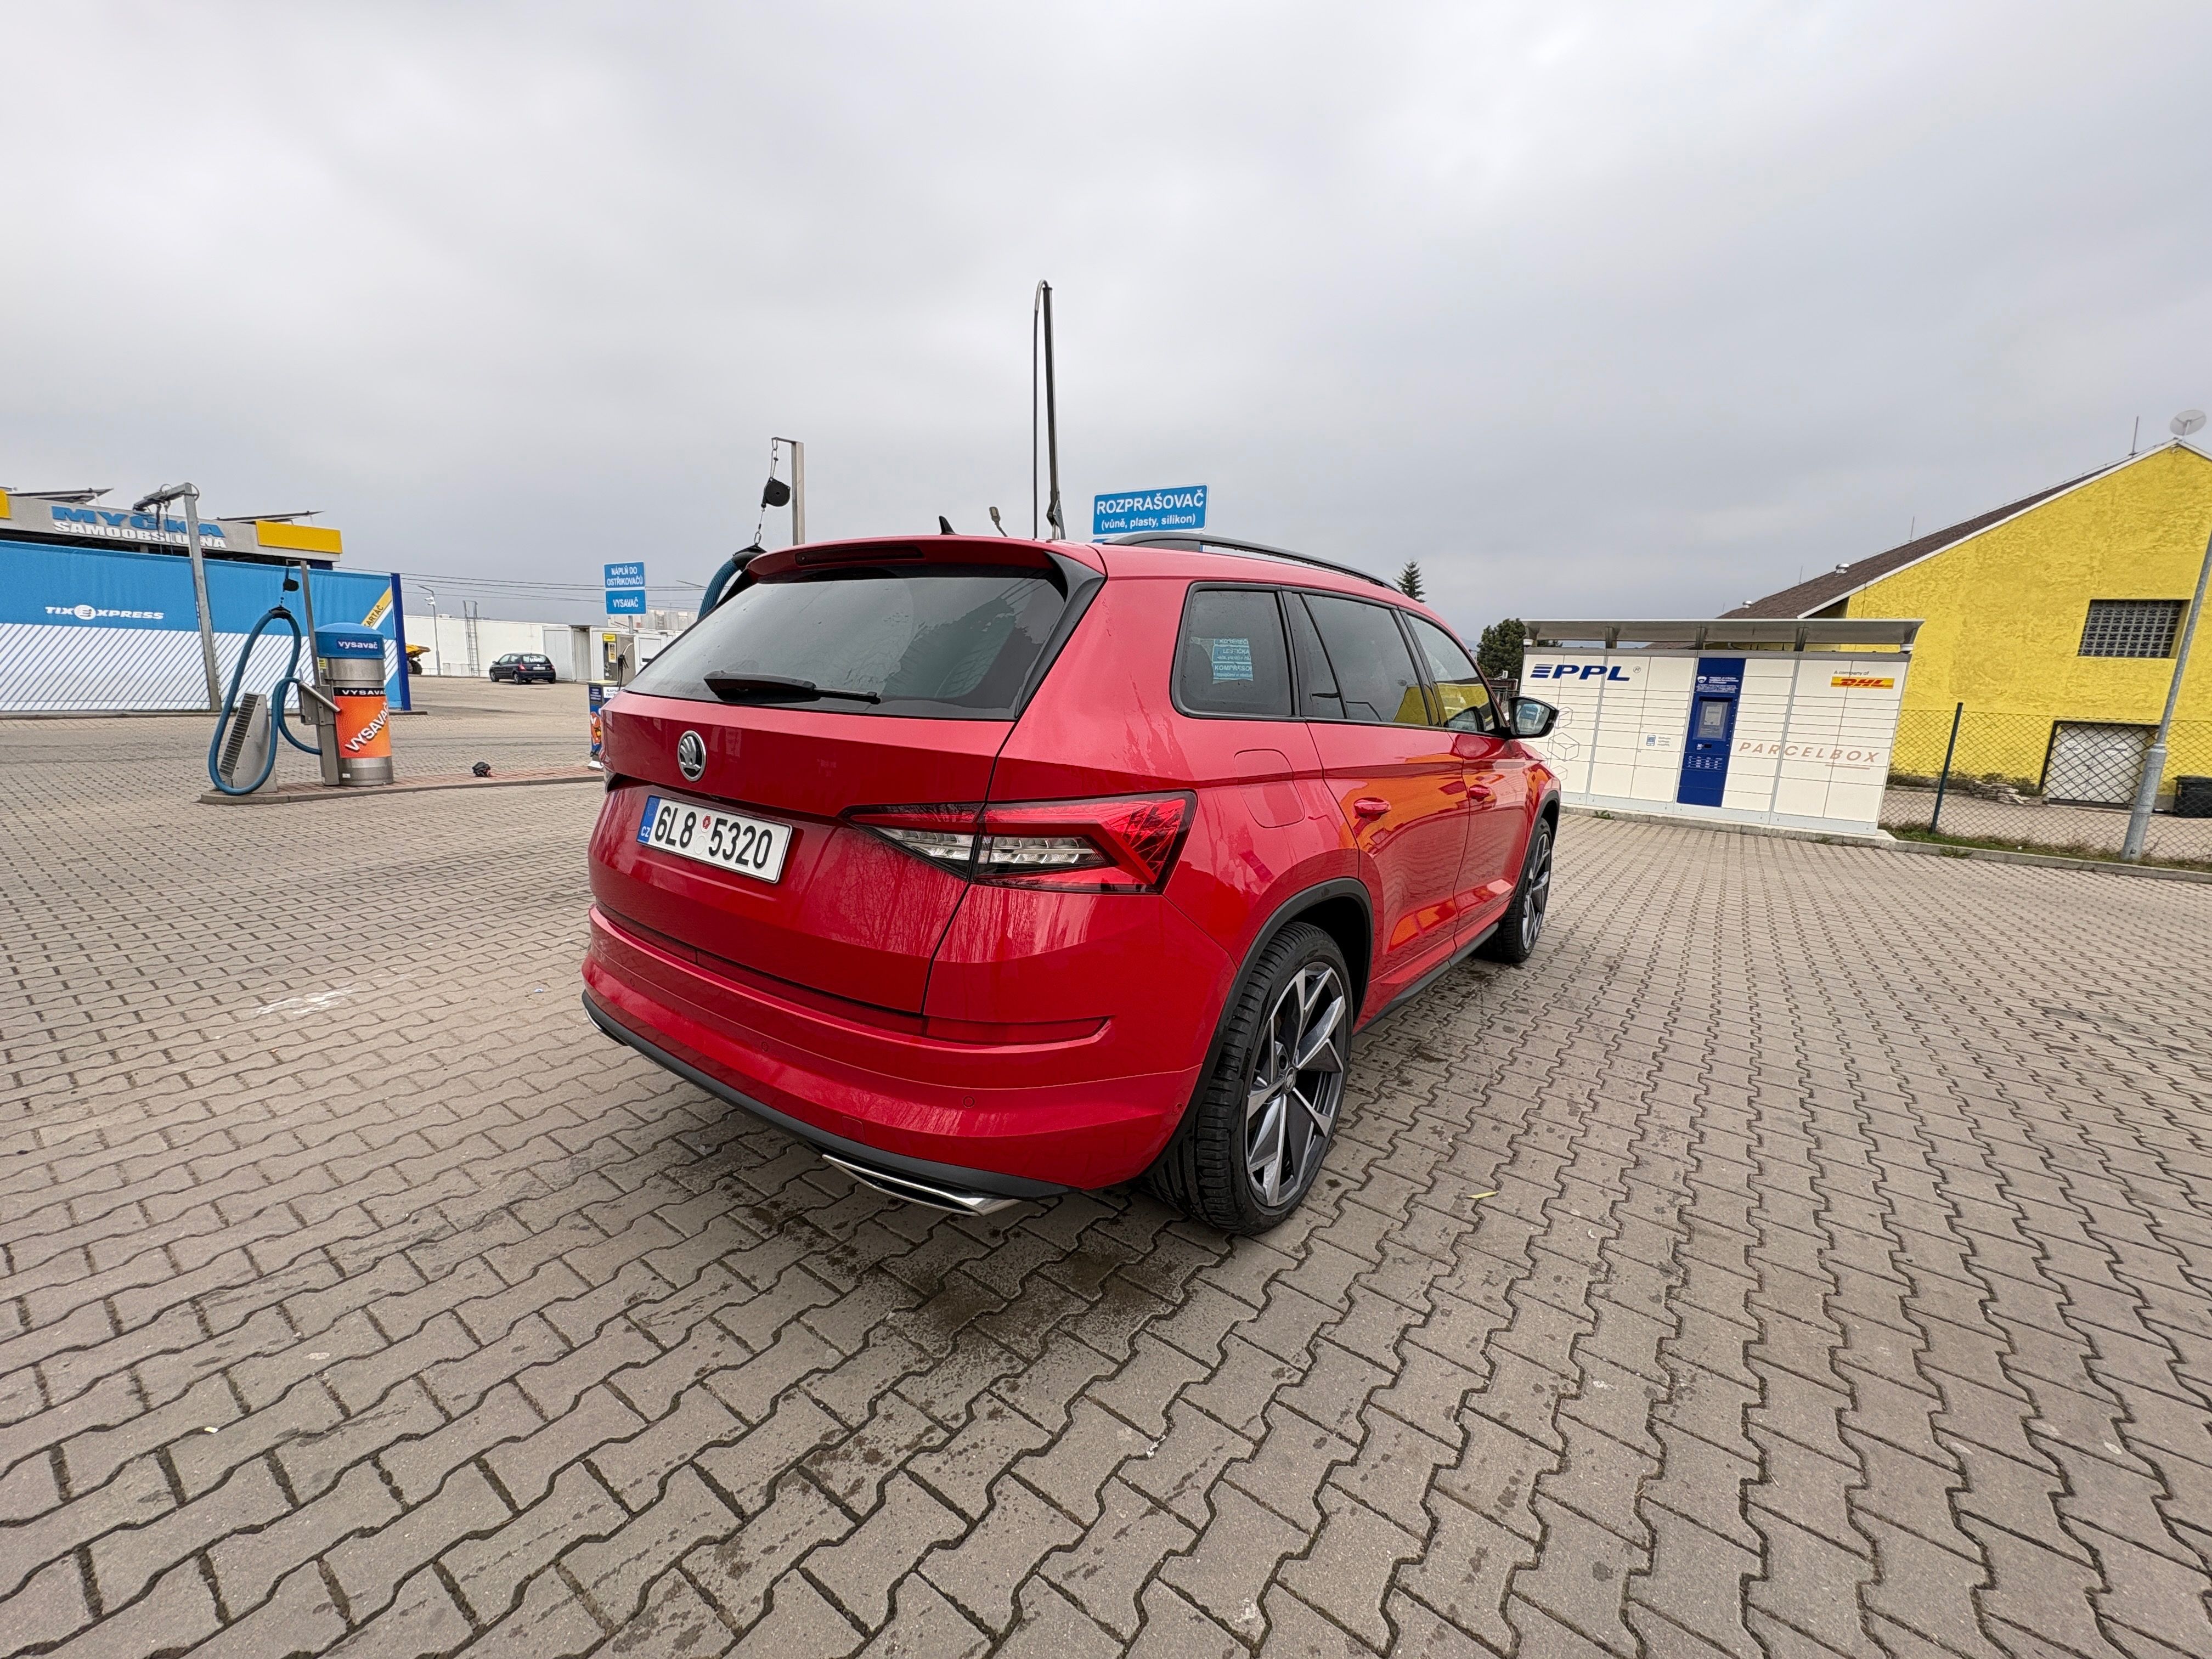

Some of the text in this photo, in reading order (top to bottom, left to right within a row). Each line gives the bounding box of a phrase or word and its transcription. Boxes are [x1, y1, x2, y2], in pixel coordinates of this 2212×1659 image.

[1101, 513, 1196, 531] (vůně, plasty, silikon)
[54, 521, 227, 549] SAMOOBSLUNÁ
[611, 566, 637, 575] NÁPLŇ DO
[607, 574, 643, 586] OSTŘIKOVAČŮ
[613, 596, 639, 608] VYSAVAČ
[338, 641, 378, 650] vysavač
[1551, 664, 1630, 681] PPL
[1838, 678, 1884, 687] DHL
[1738, 742, 1880, 763] PARCELBOX
[641, 826, 651, 838] CZ
[654, 805, 772, 869] 6L8 5320
